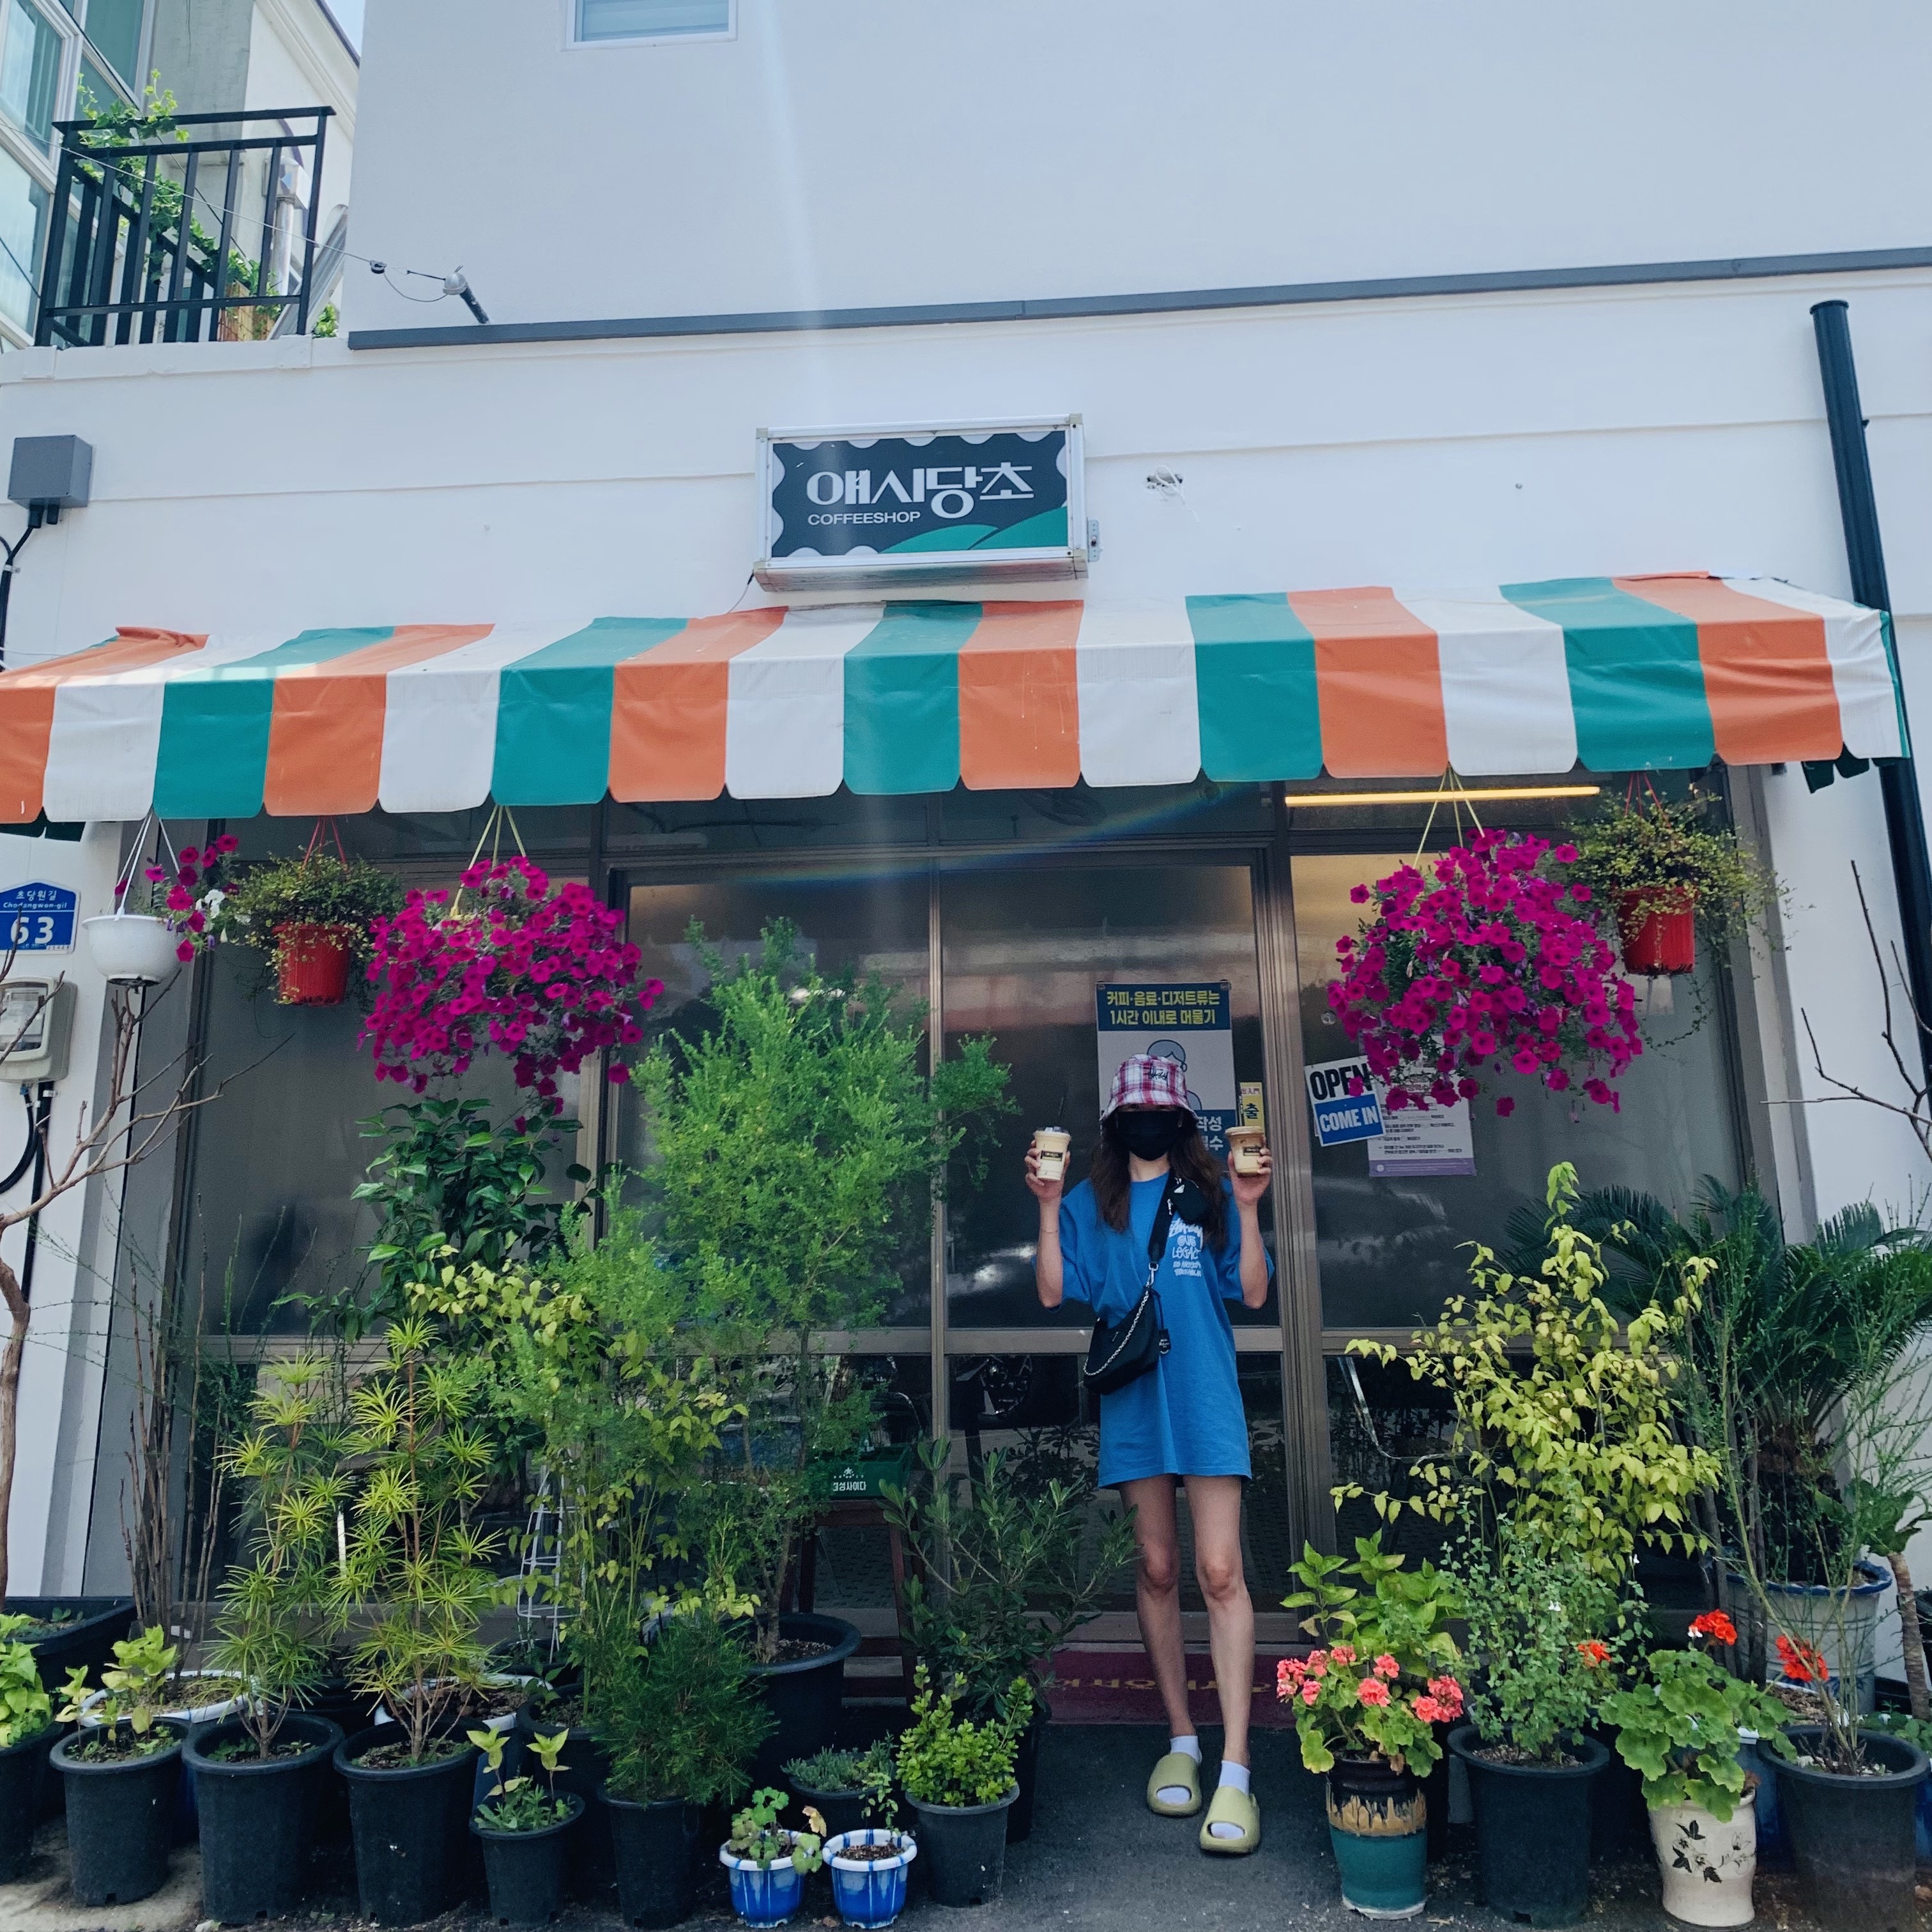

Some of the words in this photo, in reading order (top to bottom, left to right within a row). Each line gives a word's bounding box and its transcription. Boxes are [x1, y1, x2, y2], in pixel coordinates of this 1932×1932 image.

[806, 462, 1034, 519] 애시당초
[807, 510, 921, 526] COFFEESHOP
[15, 890, 57, 901] 초당원길
[10, 916, 54, 945] 63
[1110, 1010, 1139, 1025] 1시간
[1142, 1010, 1177, 1025] 이내로
[1180, 1009, 1216, 1025] 머물기
[1310, 1063, 1373, 1101] OPEN
[1319, 1108, 1361, 1133] COME
[1362, 1105, 1380, 1125] IN
